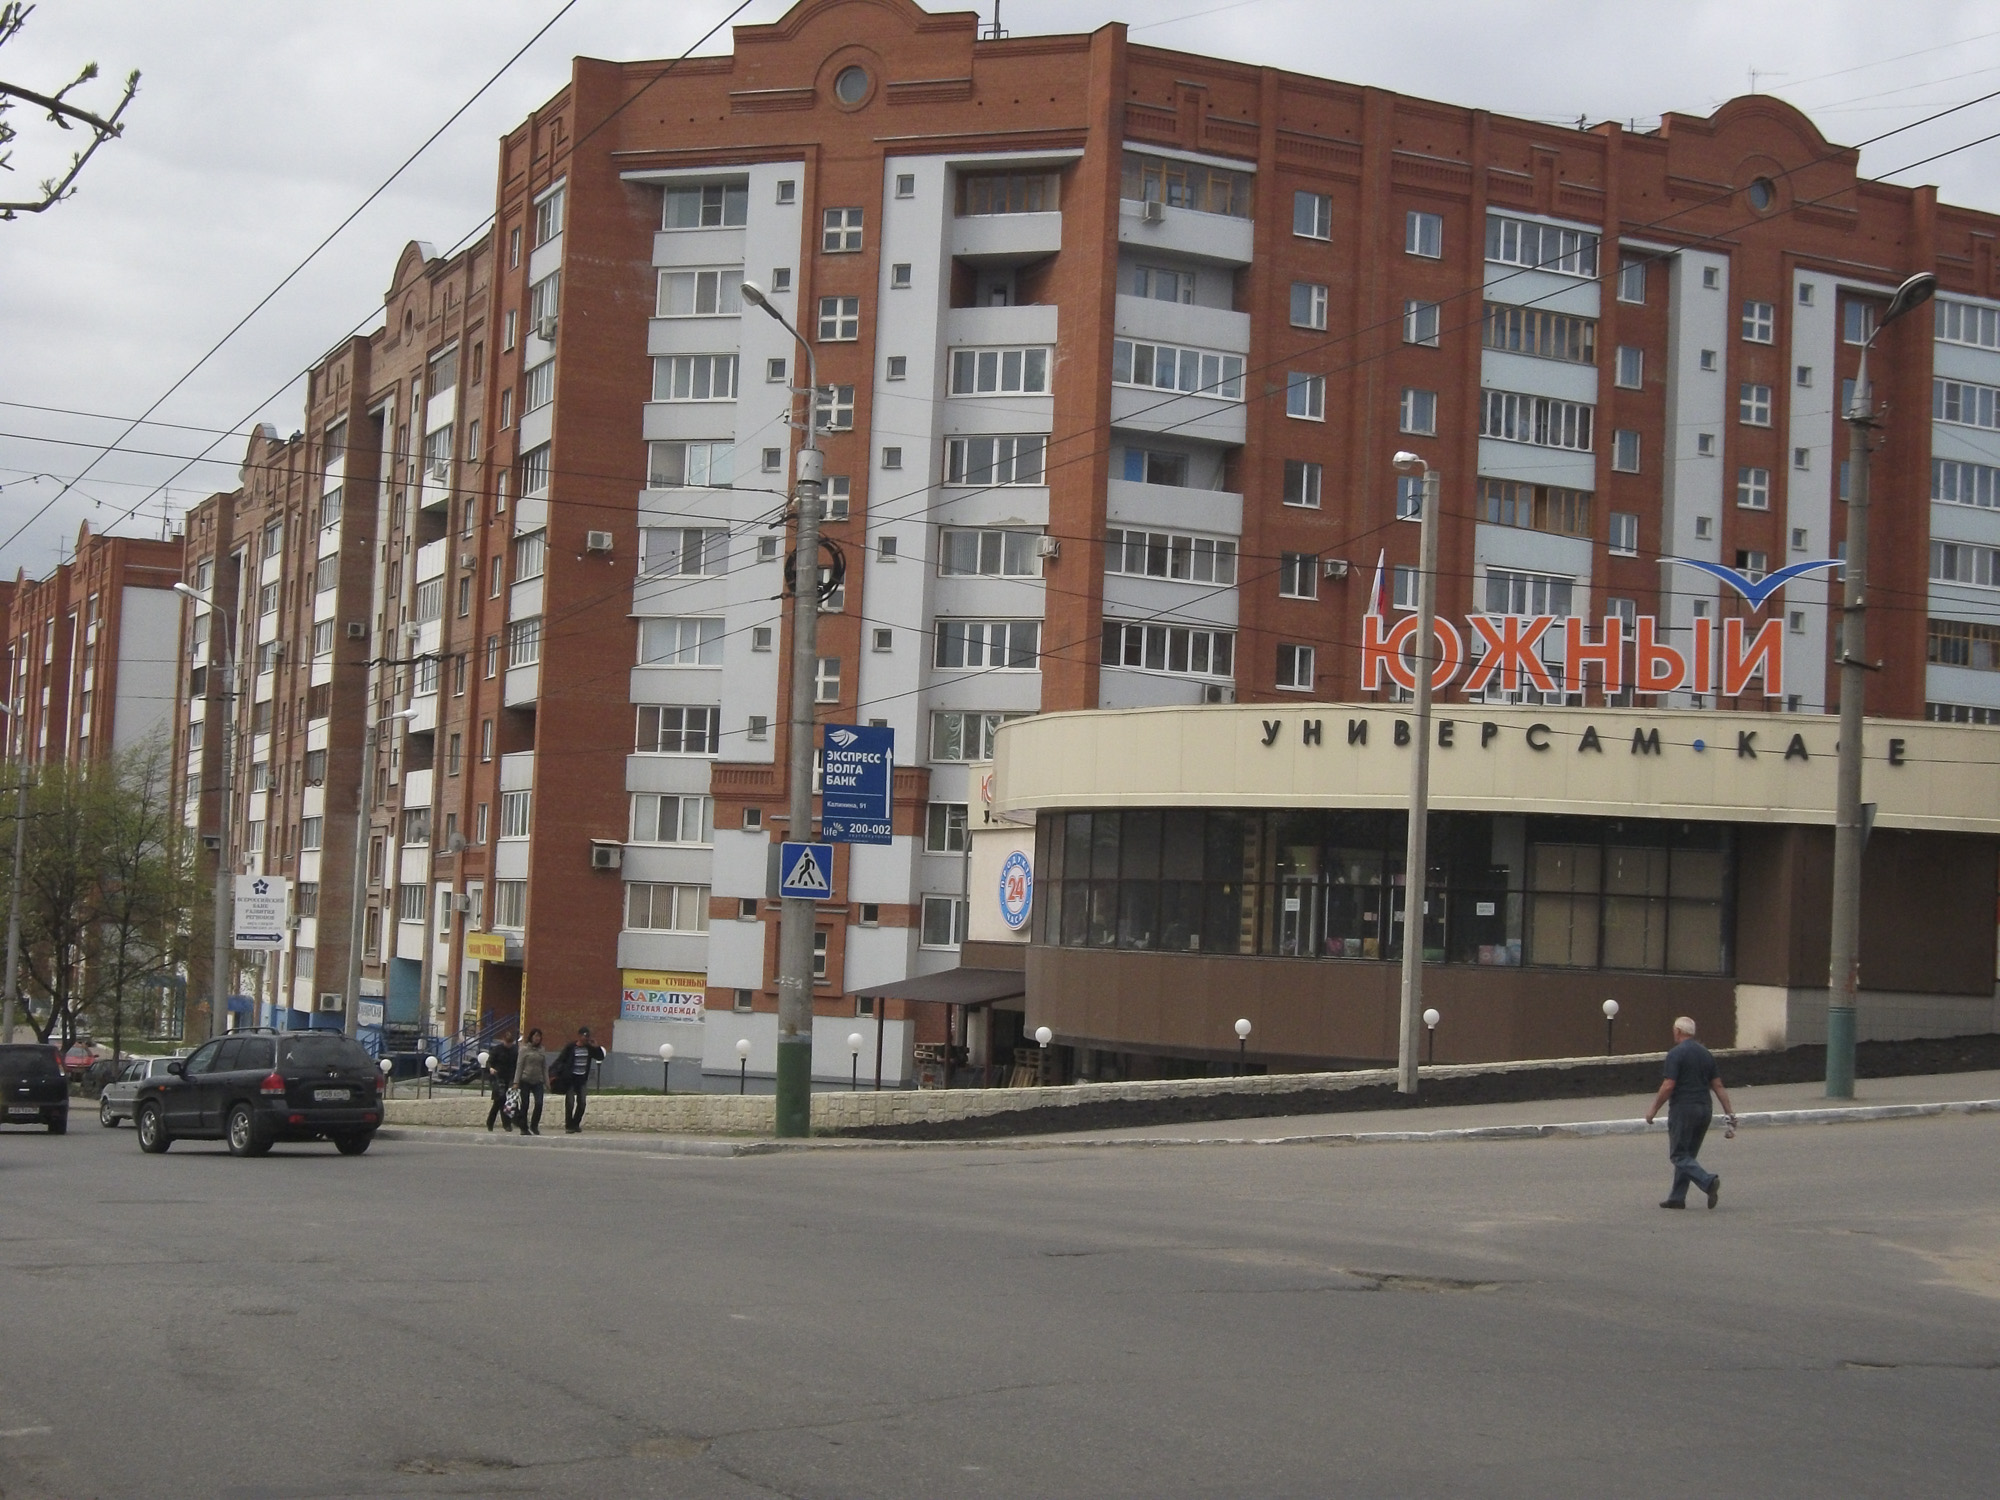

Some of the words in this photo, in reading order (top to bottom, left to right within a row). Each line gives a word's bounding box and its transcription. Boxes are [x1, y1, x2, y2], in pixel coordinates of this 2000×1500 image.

[1261, 718, 1662, 756] УНИВЕРСАМ
[1738, 729, 1907, 767] КАЕ
[826, 750, 881, 764] ЭКСПРЕСС
[826, 763, 863, 775] ВОЛГА
[826, 775, 857, 787] БАНК
[823, 826, 838, 837] life
[849, 823, 891, 835] 200-002
[1000, 854, 1032, 888] ПРОДУКТЫ
[1008, 876, 1025, 901] 24
[1006, 911, 1023, 925] ЧАСА
[623, 990, 703, 1005] КАРАПУЗ
[625, 1003, 660, 1012] ДЕТСКАЯ
[663, 1006, 696, 1015] ОДЕЖДА
